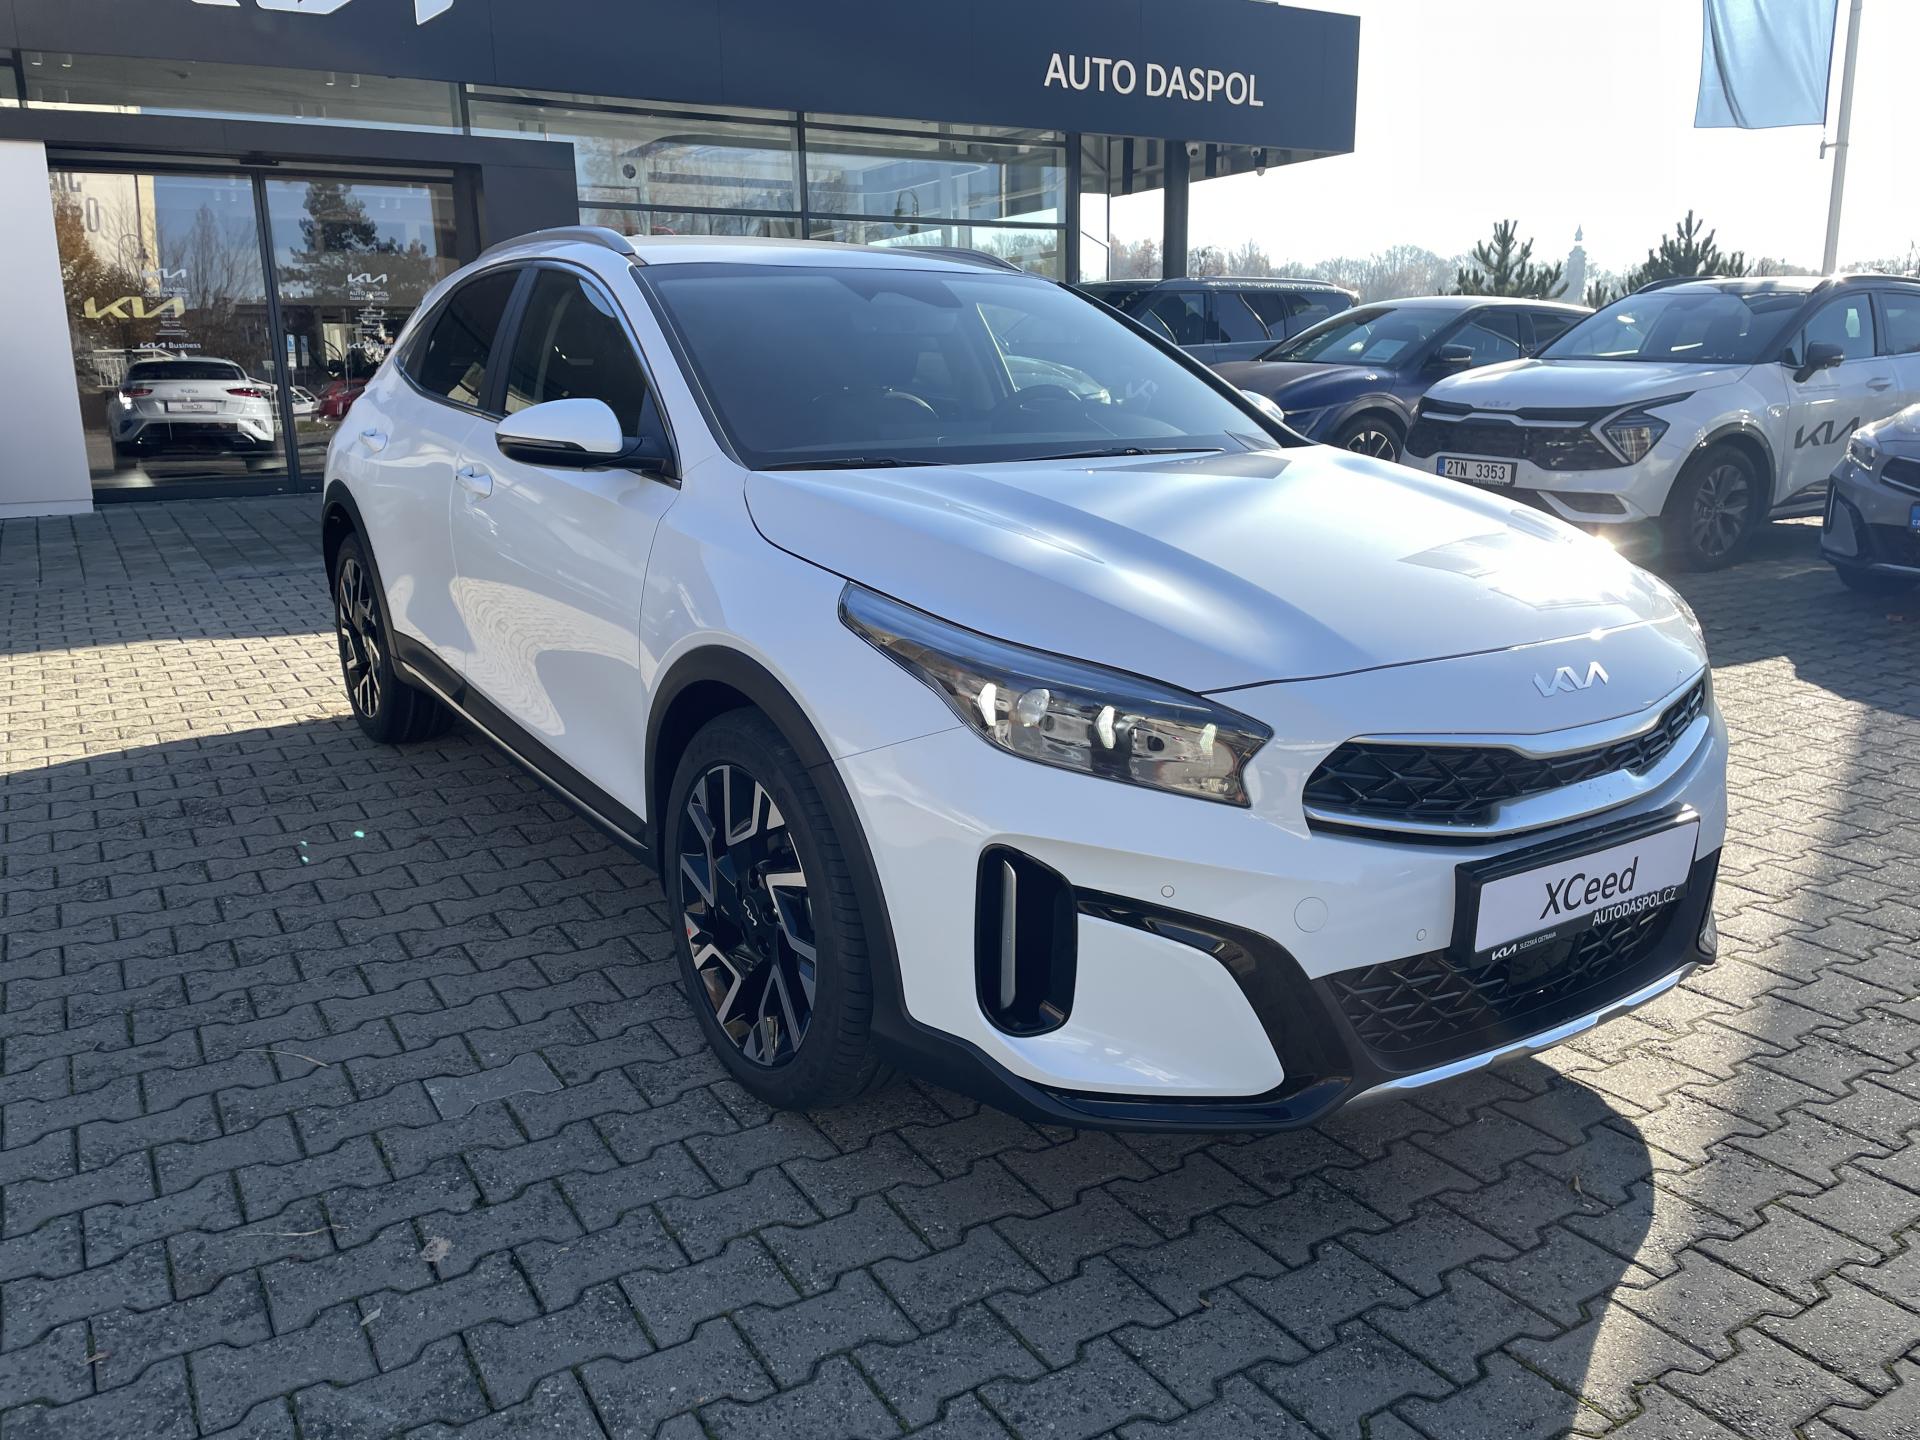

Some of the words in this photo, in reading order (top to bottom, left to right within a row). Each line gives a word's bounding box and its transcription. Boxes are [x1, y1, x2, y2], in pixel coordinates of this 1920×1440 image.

[1044, 53, 1137, 94] AUTO
[1146, 63, 1264, 107] DASPOL
[347, 273, 388, 284] KIA
[84, 296, 186, 318] KIA
[168, 341, 202, 349] Business
[1446, 460, 1468, 477] 2TN
[1475, 463, 1507, 480] 3353
[1532, 661, 1609, 697] KIA
[1592, 887, 1677, 927] AUTODASPOL.CZ
[1491, 943, 1517, 961] KIA
